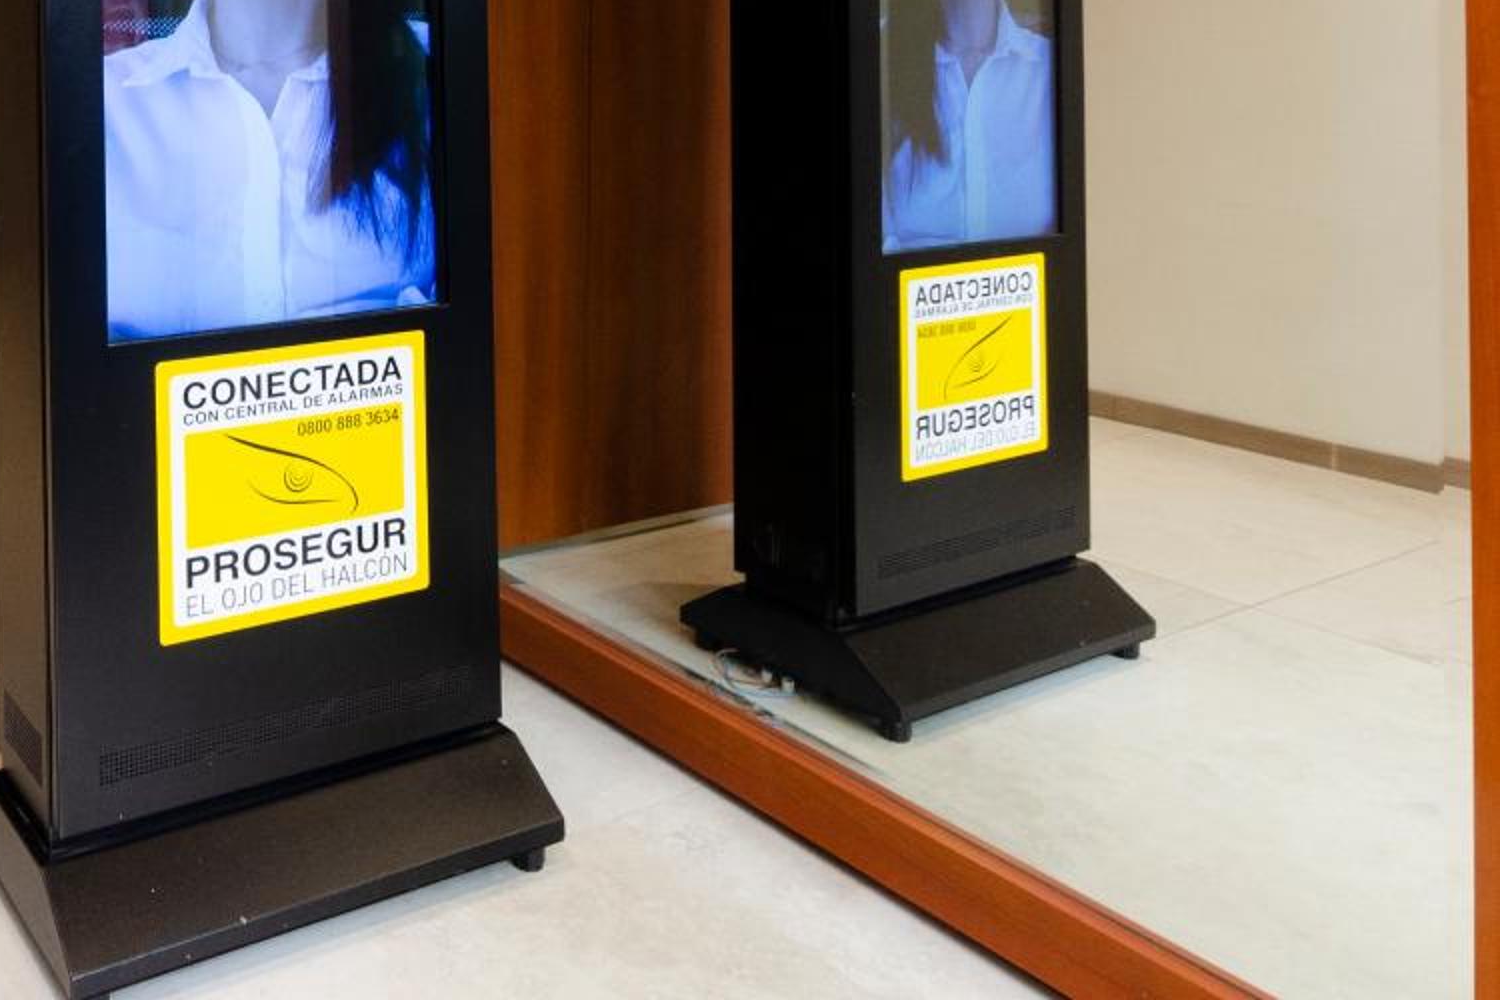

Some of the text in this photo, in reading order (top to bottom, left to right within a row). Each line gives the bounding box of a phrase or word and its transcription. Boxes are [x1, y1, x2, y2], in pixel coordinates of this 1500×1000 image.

[183, 356, 402, 410] CONECTADA
[183, 384, 403, 426] CON CENTRAL DE ALARMAS
[297, 408, 399, 436] 0800 888 3634
[186, 517, 406, 589] PROSEGUR
[187, 551, 408, 618] EL OJO DEL HALCÓN
